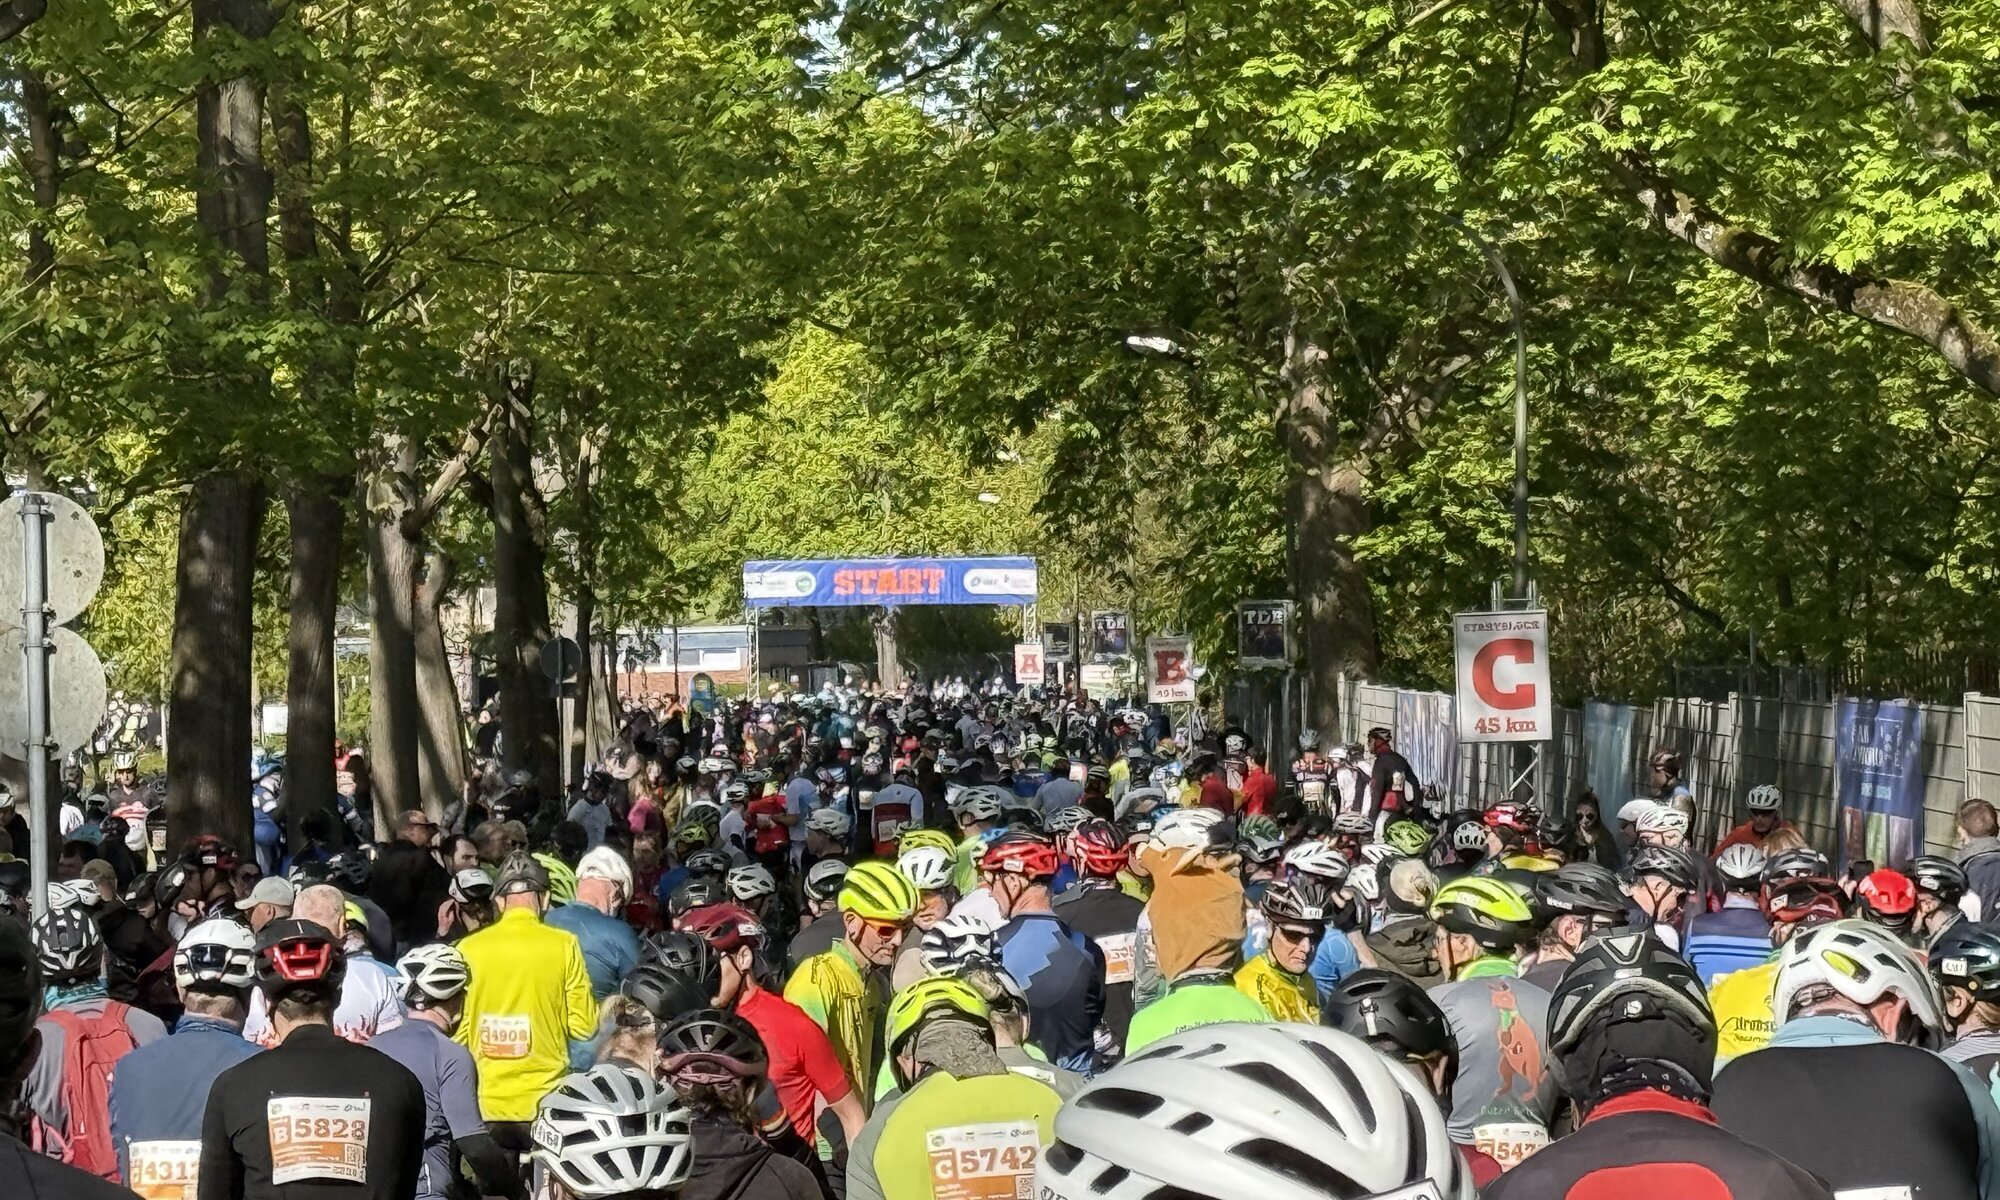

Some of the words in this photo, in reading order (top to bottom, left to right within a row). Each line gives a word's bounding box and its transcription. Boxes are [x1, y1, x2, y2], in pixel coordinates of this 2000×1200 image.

[833, 569, 944, 595] START
[1019, 654, 1041, 674] A
[1154, 651, 1187, 685] B
[1472, 638, 1536, 711] C
[1474, 717, 1502, 734] 45
[1505, 716, 1536, 733] km
[934, 1159, 955, 1180] C
[958, 1145, 1036, 1174] 5742
